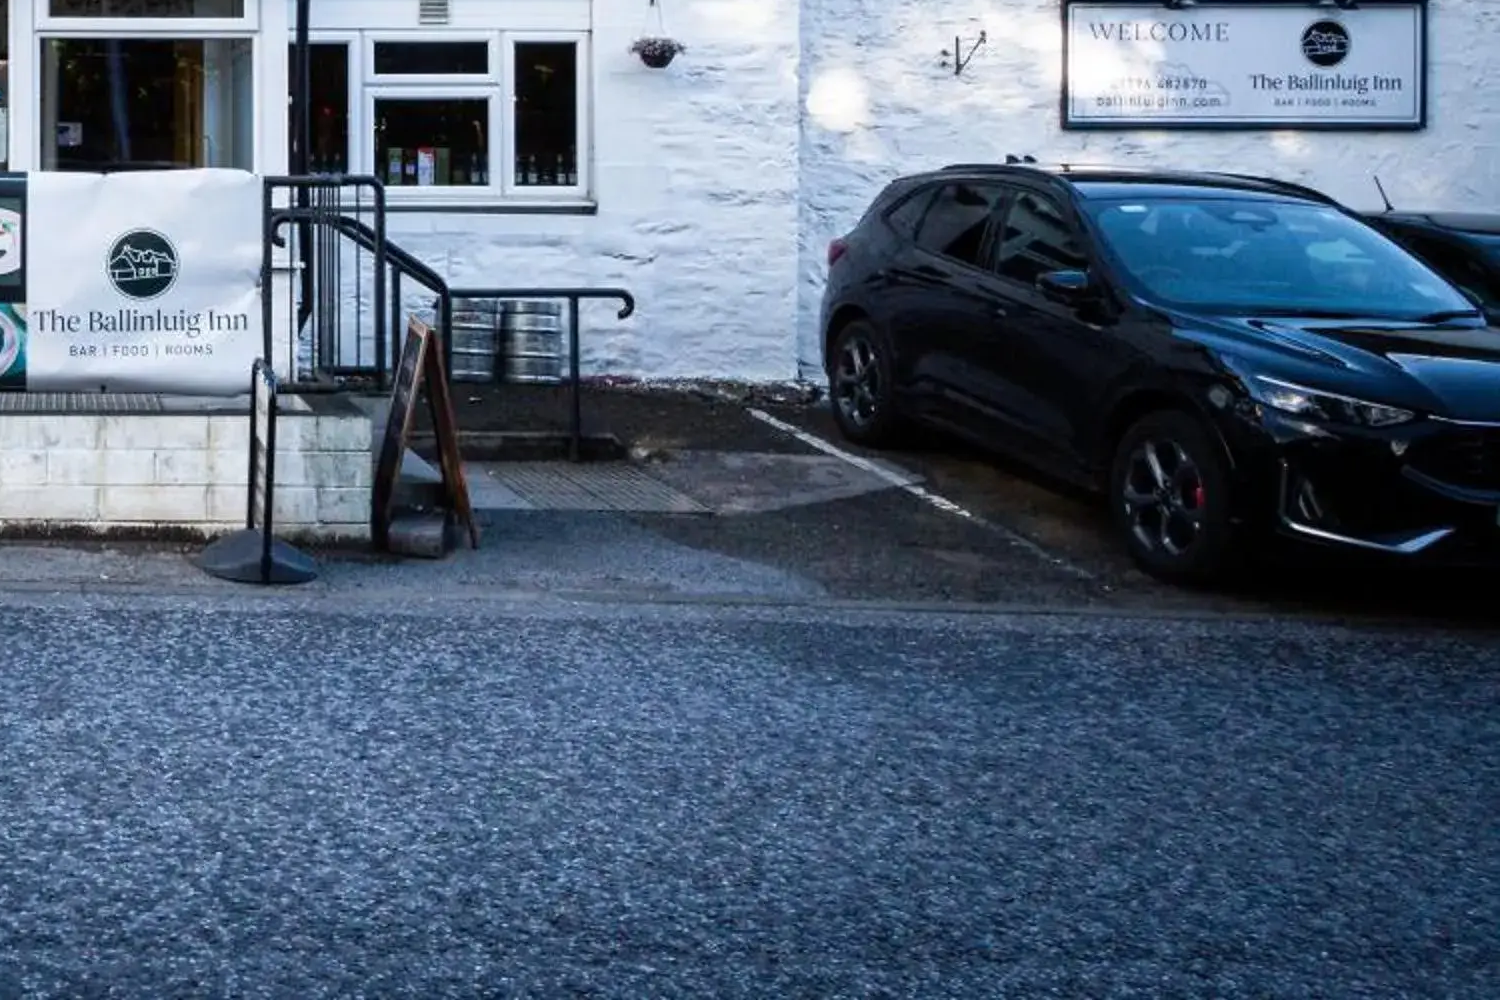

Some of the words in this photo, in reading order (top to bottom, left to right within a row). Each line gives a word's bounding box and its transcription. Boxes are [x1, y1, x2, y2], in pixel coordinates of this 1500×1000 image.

[1089, 22, 1229, 42] WELCOME
[1249, 74, 1282, 90] The
[1287, 74, 1369, 95] Ballinluig
[1373, 74, 1402, 91] Inn
[34, 310, 81, 332] The
[89, 310, 201, 337] Ballinluig
[209, 310, 248, 331] Inn
[69, 346, 97, 357] BAR
[113, 345, 149, 356] FOOD
[165, 344, 213, 356] ROOMS
